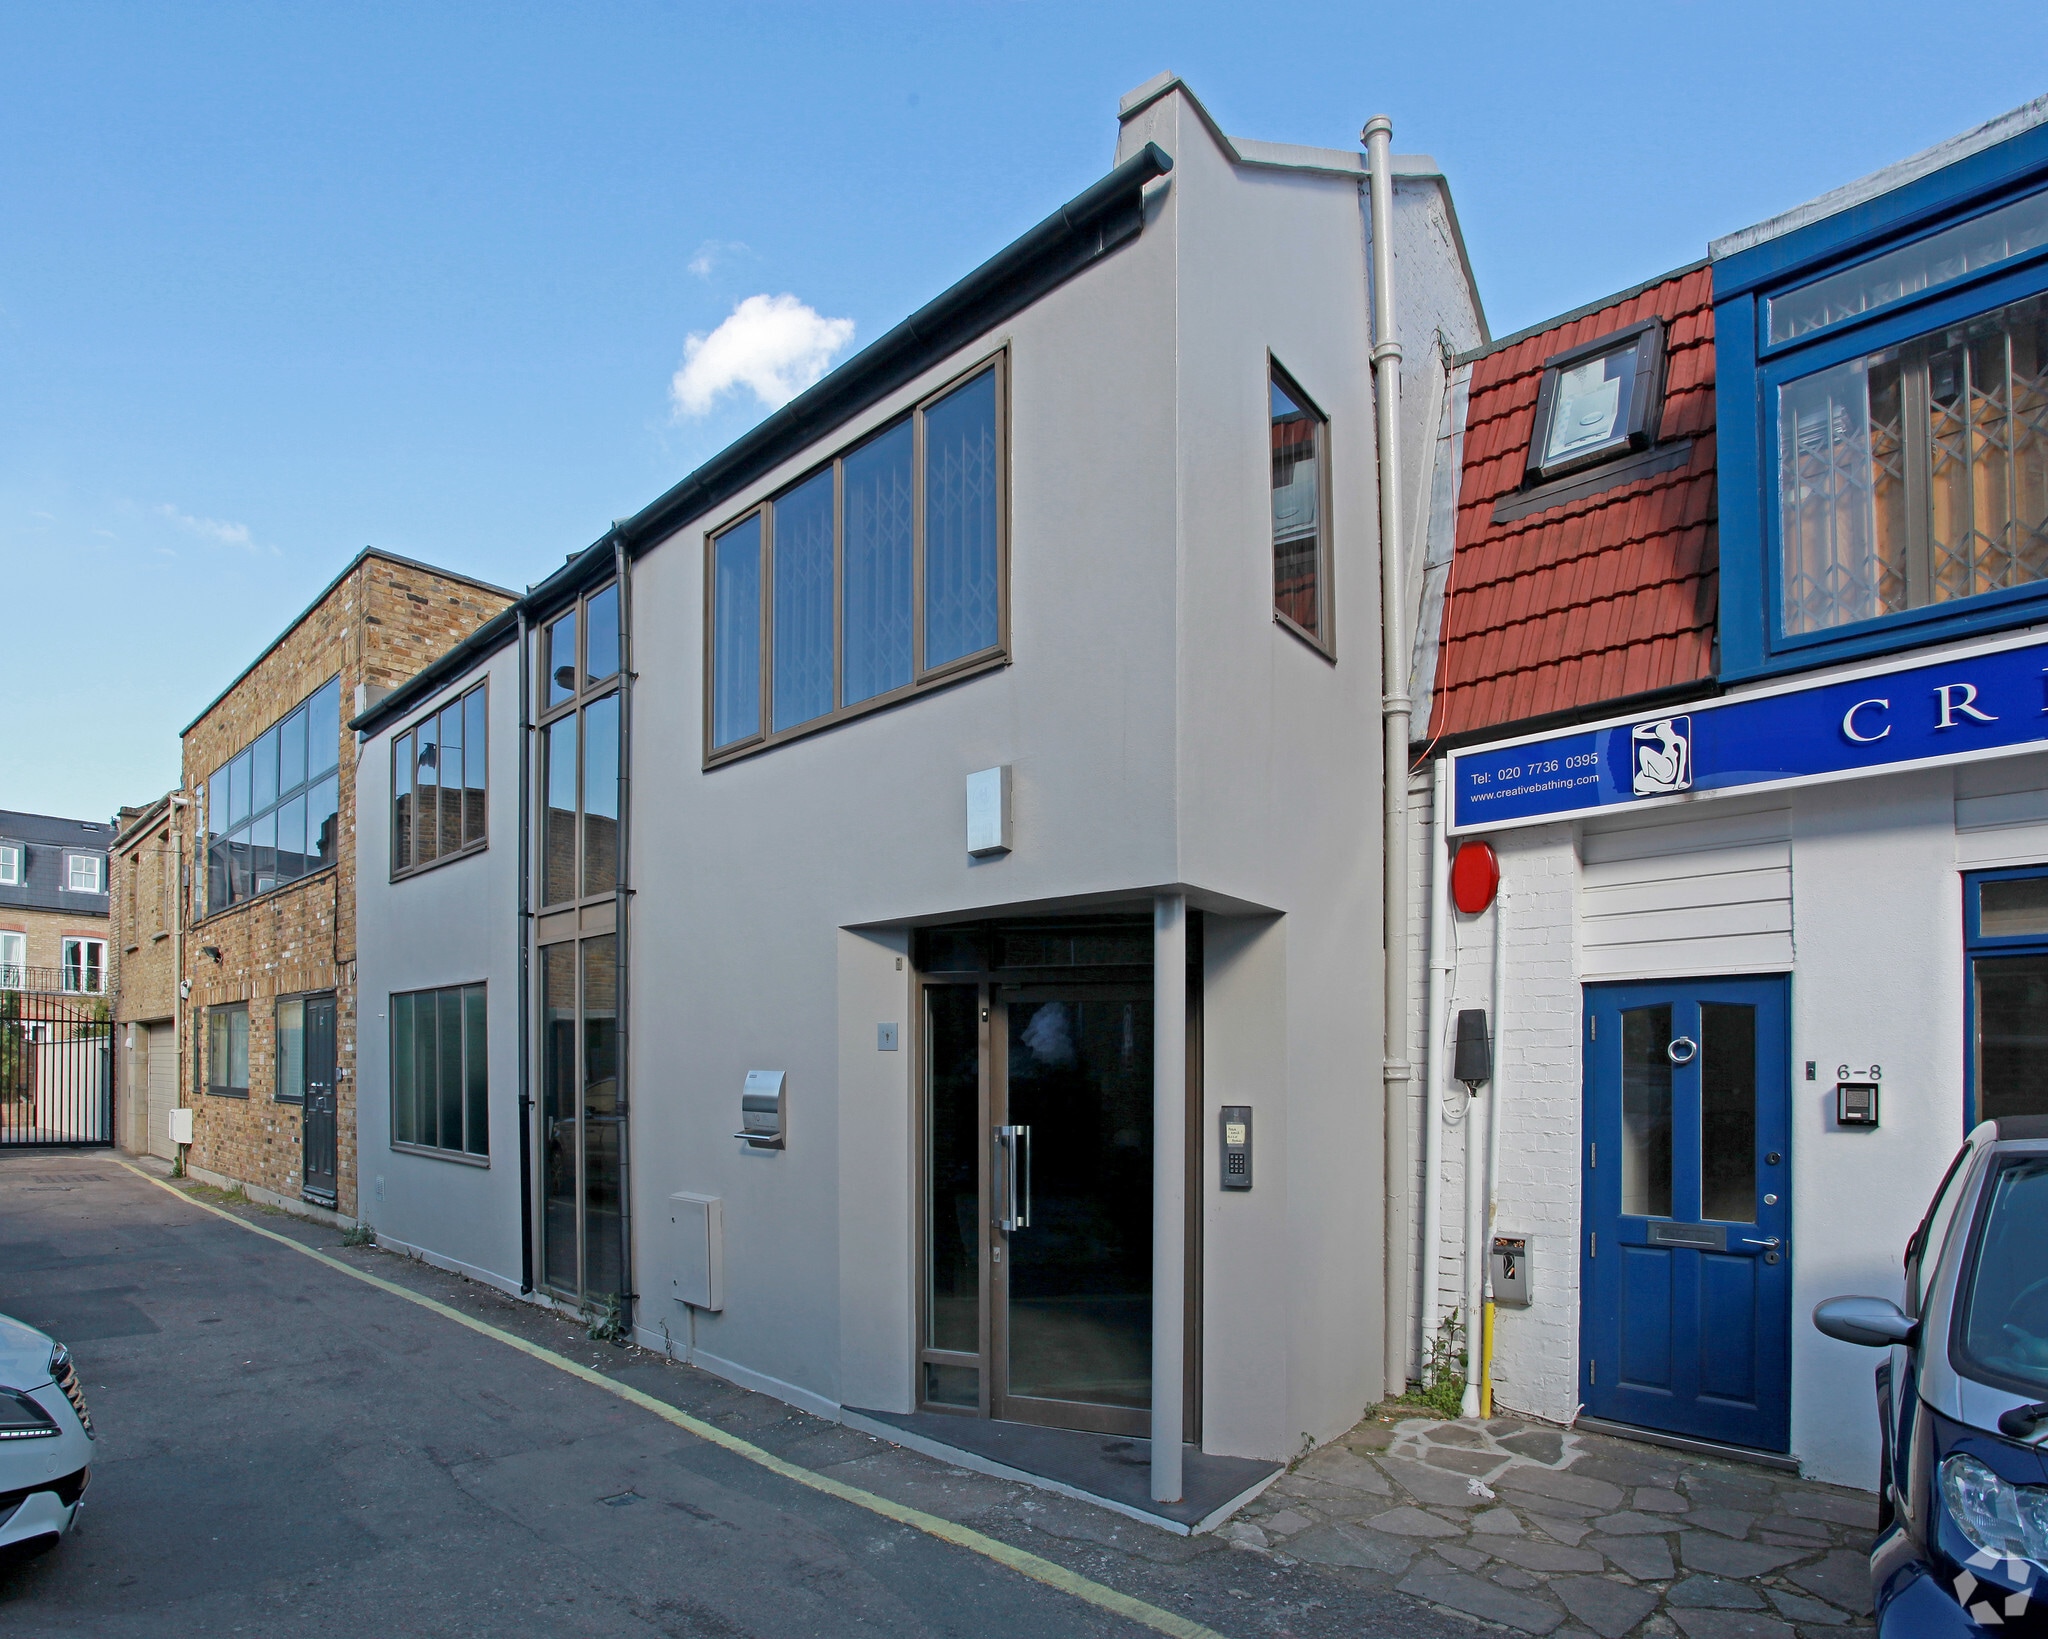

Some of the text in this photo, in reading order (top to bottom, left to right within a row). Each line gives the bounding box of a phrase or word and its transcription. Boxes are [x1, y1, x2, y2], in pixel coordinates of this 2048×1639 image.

[1843, 667, 2048, 742] CR
[1471, 752, 1599, 785] Tel: 020 7736 0395
[1470, 774, 1600, 803] www.creativebathing.com
